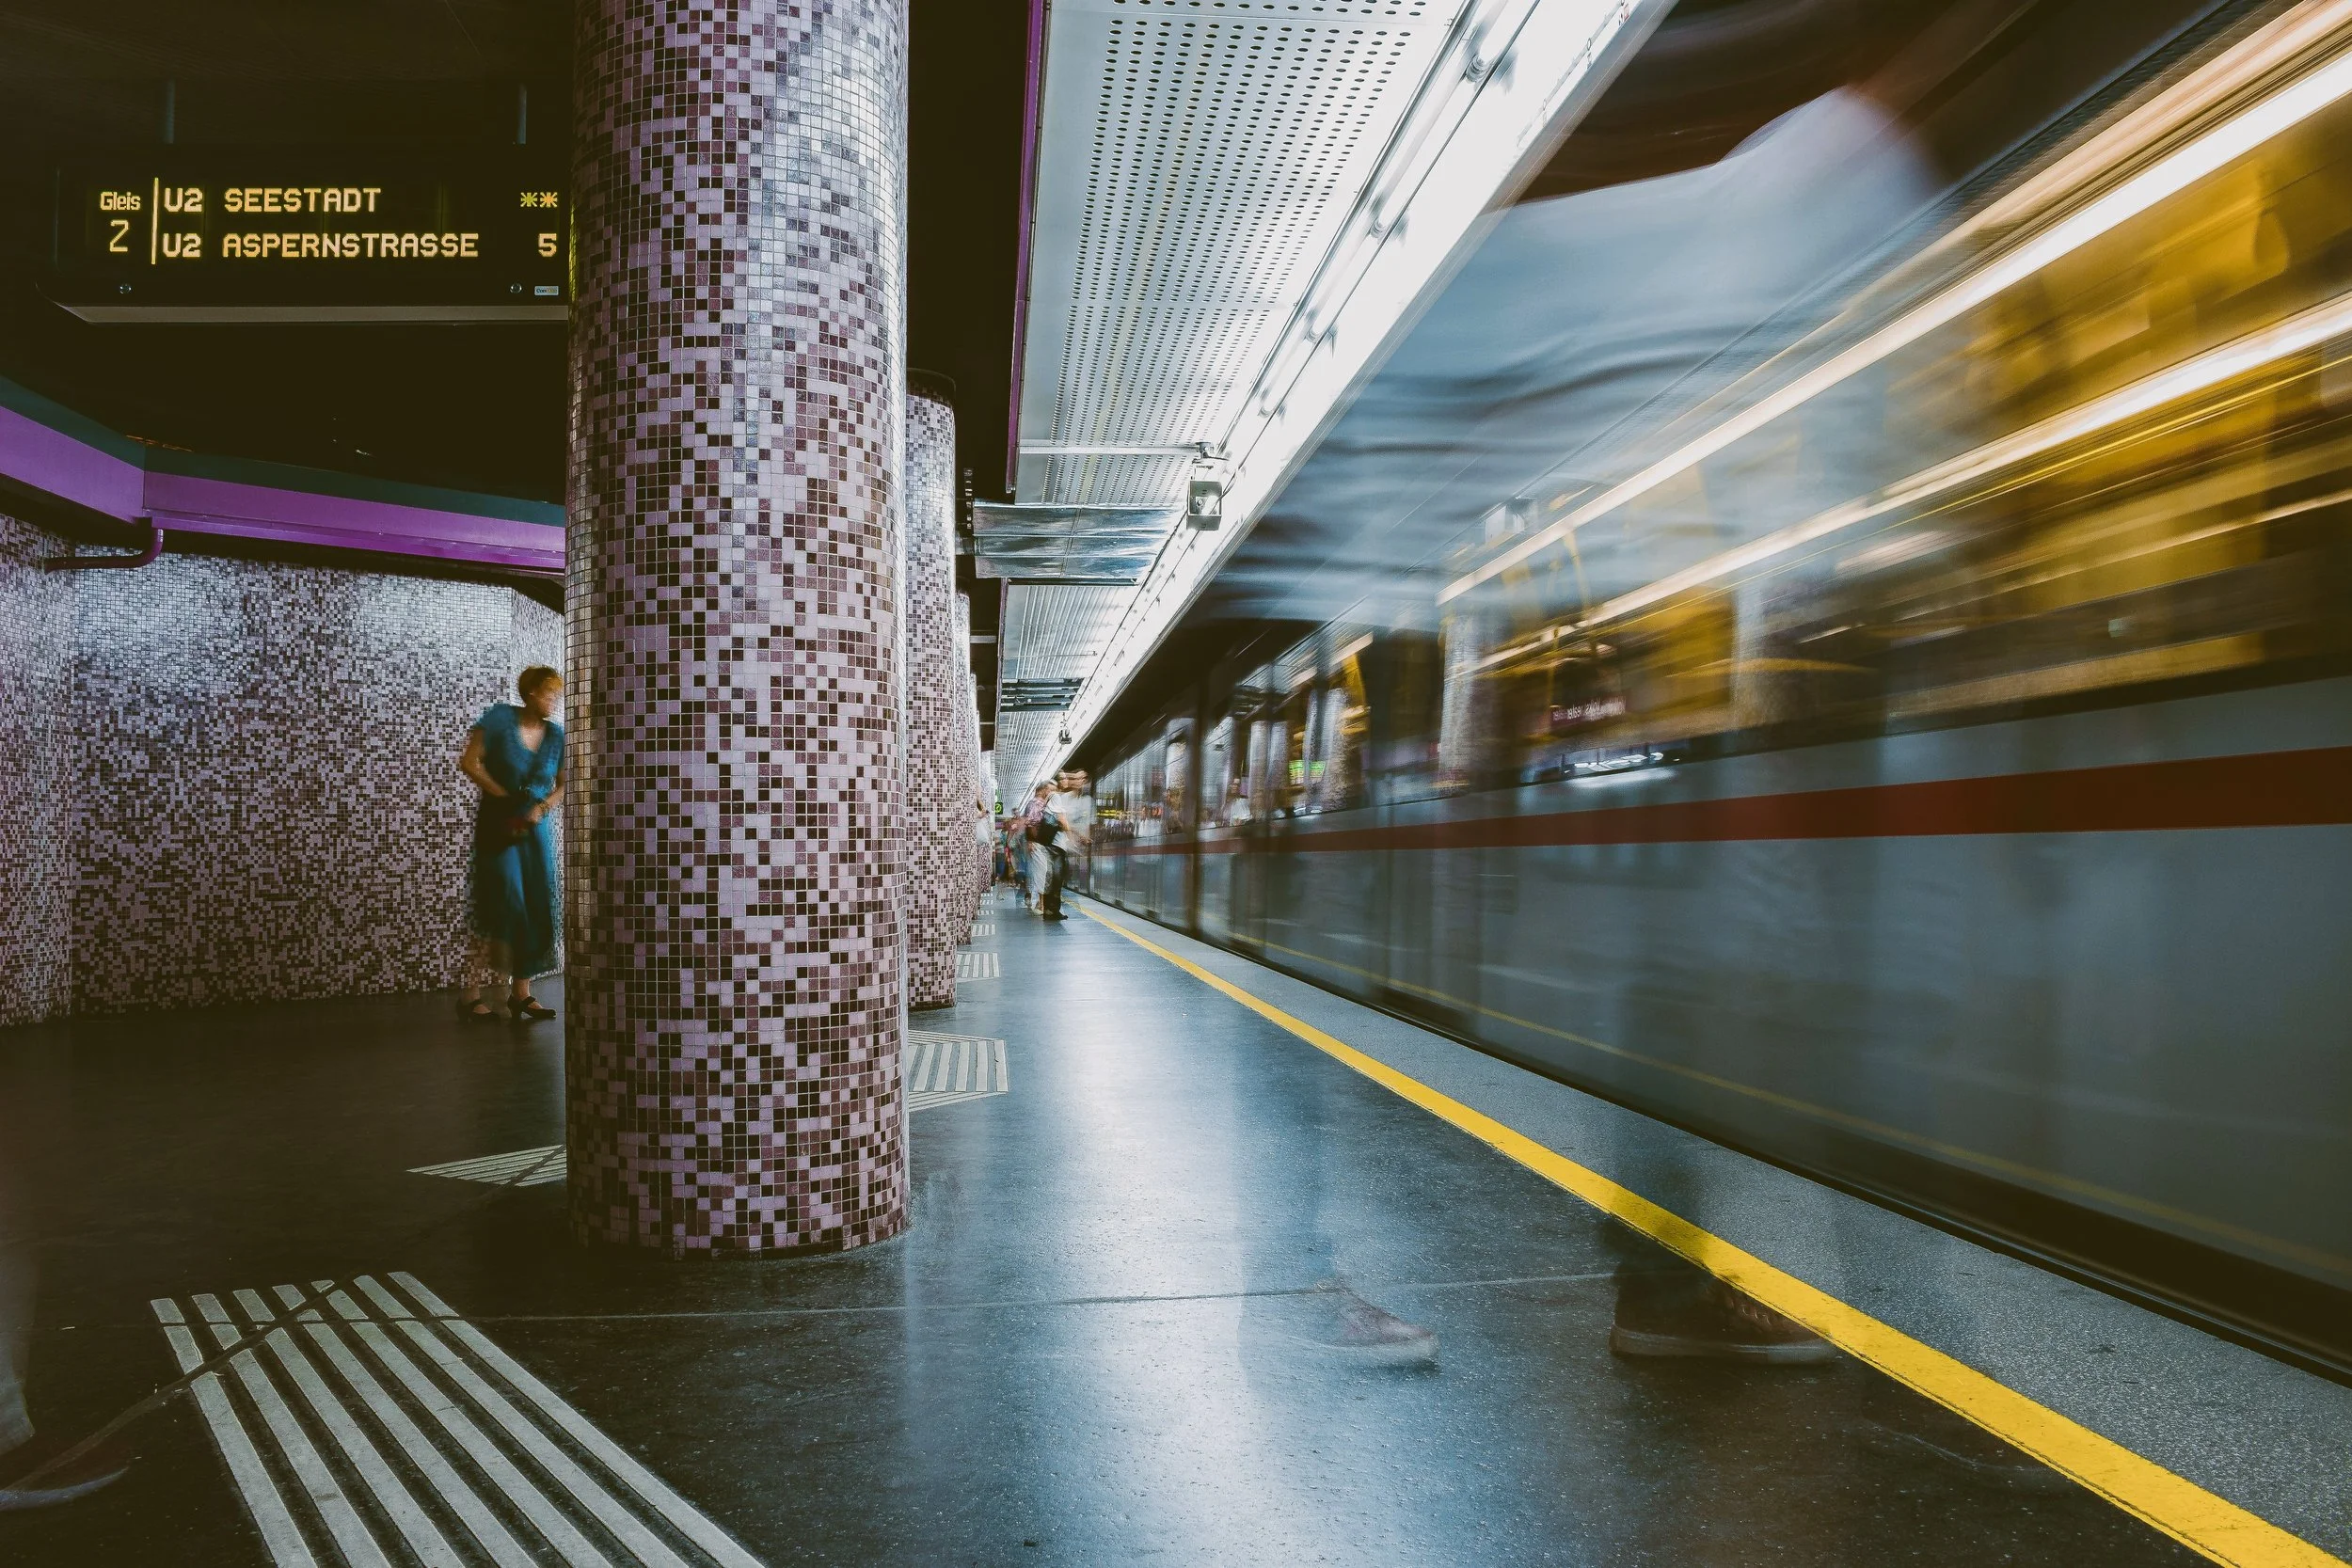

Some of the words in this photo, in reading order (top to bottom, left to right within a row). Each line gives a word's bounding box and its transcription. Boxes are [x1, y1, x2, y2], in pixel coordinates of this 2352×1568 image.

[100, 191, 141, 211] Gleis
[164, 187, 204, 213] U2
[224, 187, 382, 213] SEESTADT
[109, 219, 130, 253] 2
[162, 232, 202, 259] U2
[222, 232, 479, 258] ASPERNSTRASSE
[537, 232, 558, 258] 5
